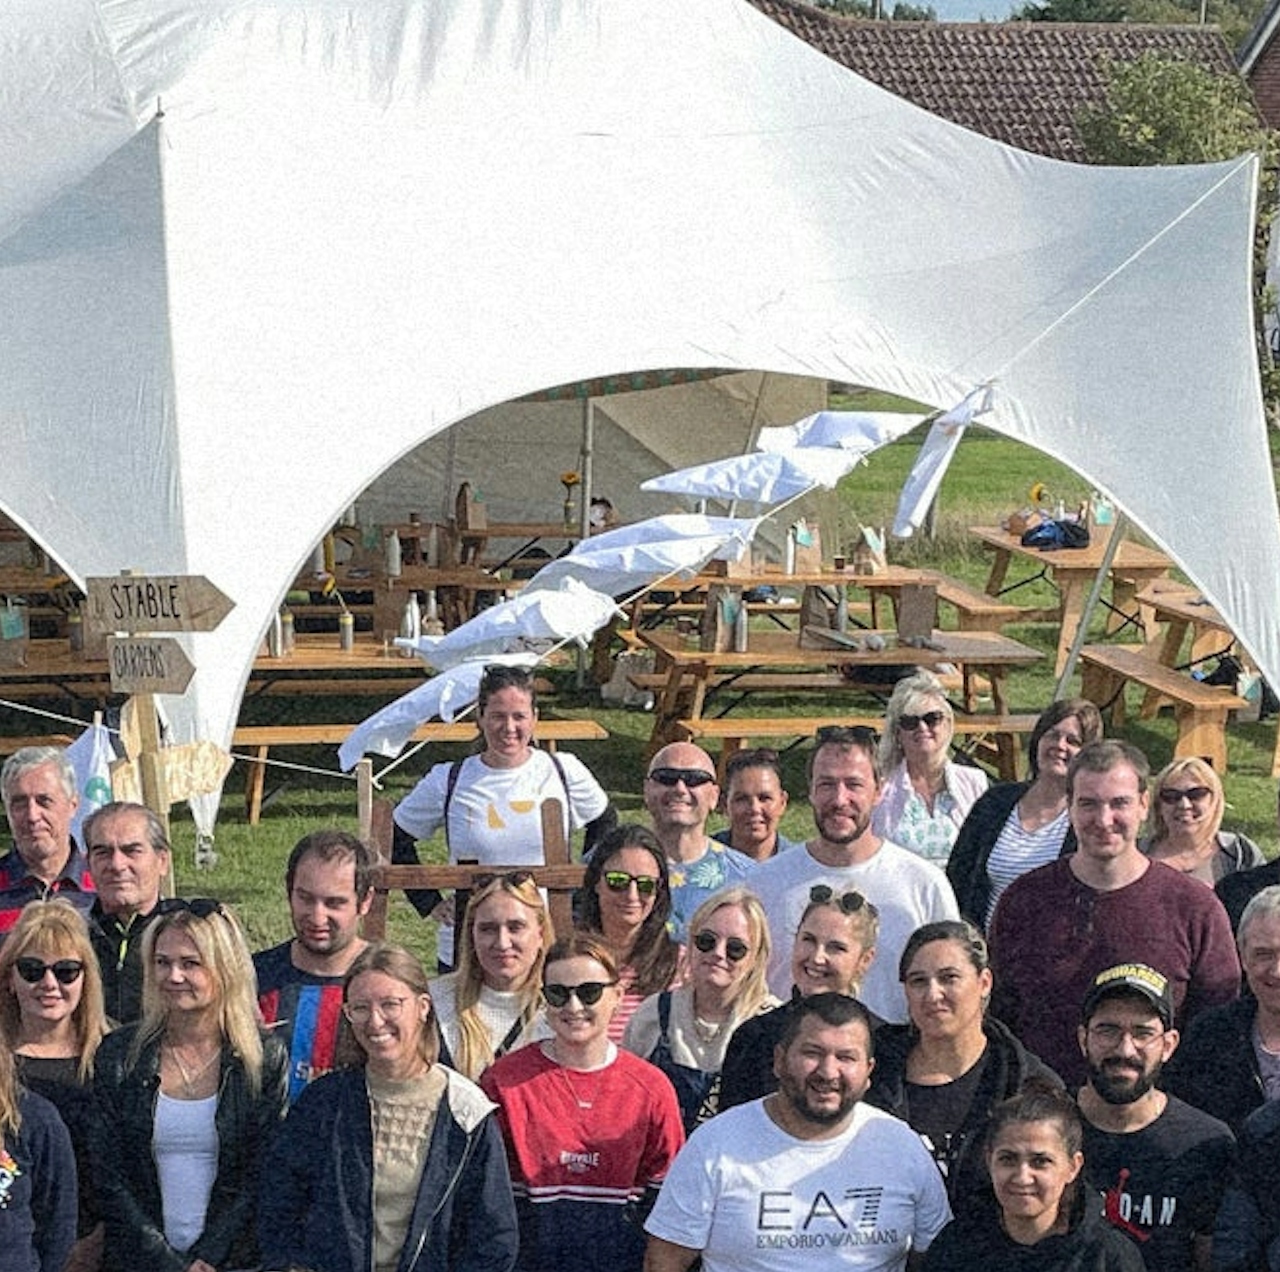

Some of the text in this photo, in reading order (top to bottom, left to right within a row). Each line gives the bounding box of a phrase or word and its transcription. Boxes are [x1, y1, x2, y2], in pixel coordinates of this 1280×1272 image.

[111, 583, 181, 620] STABLE
[757, 1186, 884, 1231] EA7
[756, 1229, 898, 1250] EMPORIO ARMANI
